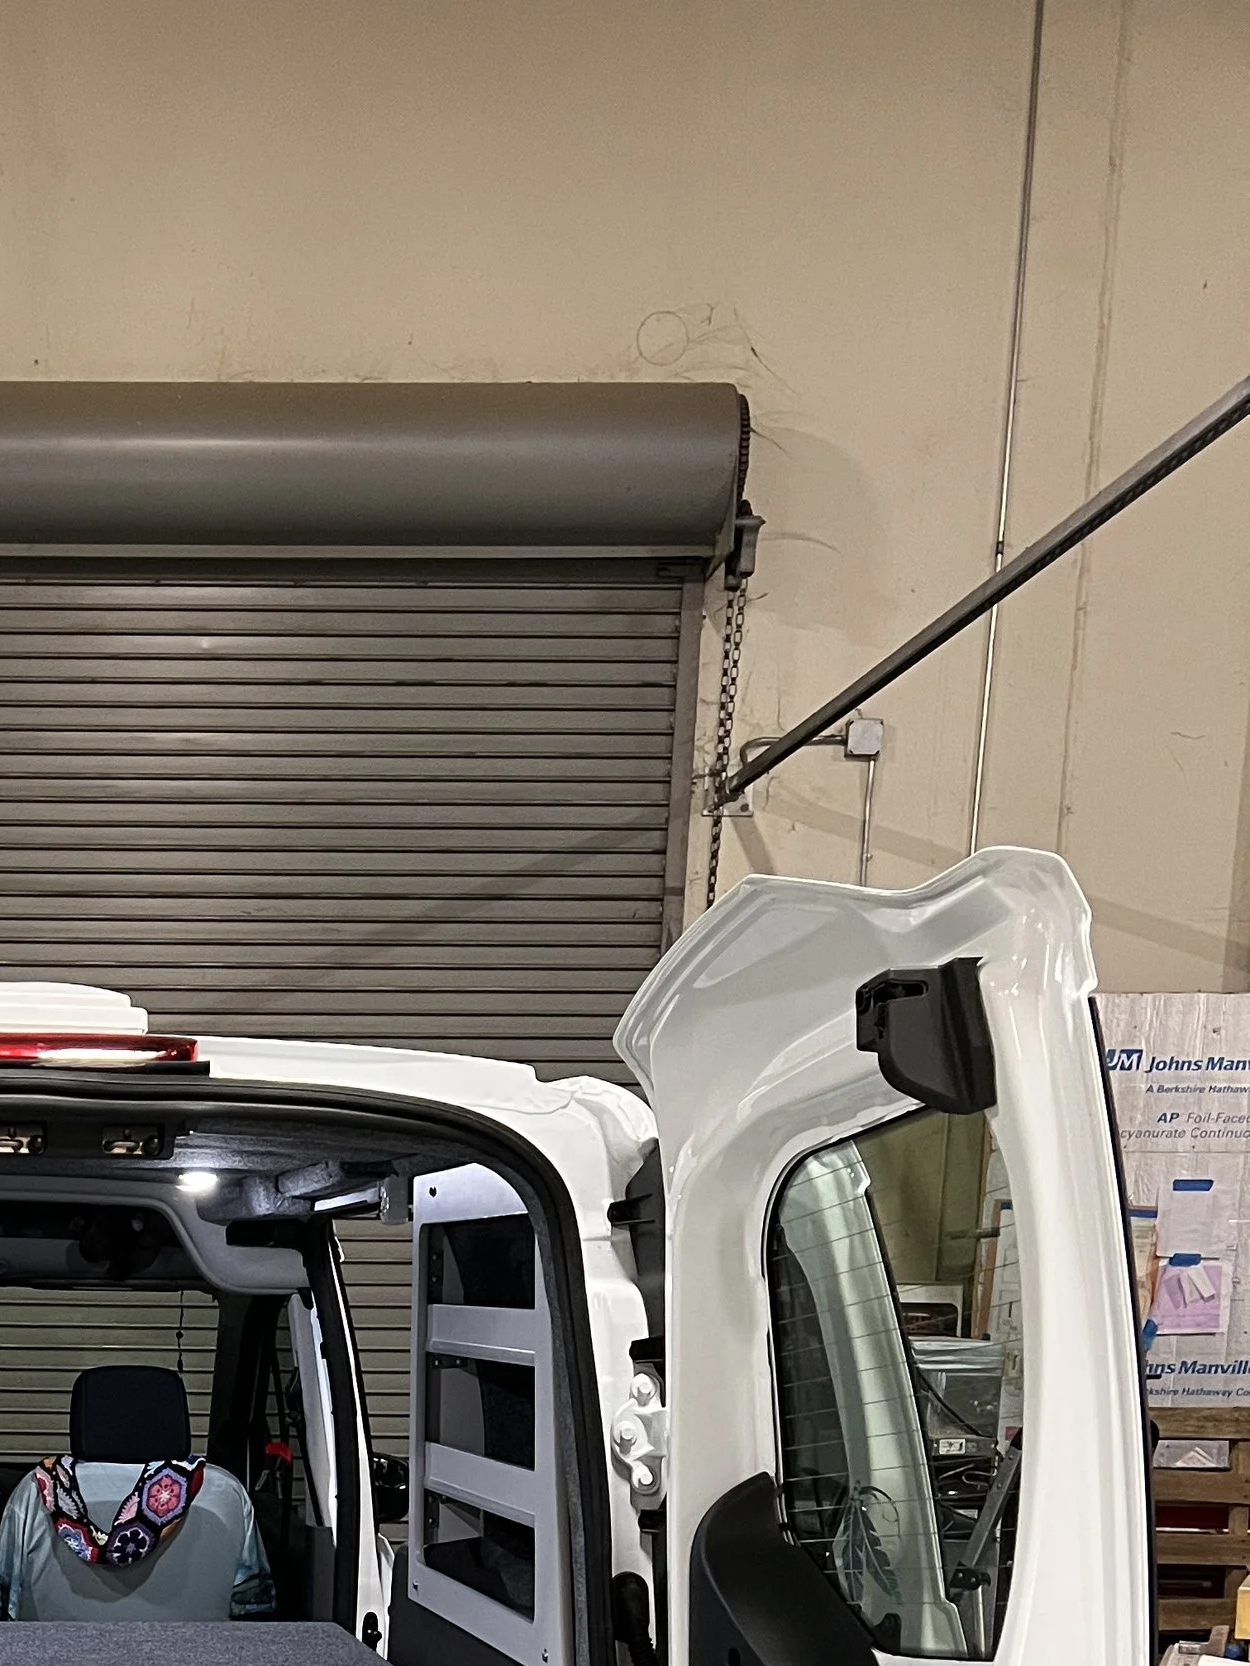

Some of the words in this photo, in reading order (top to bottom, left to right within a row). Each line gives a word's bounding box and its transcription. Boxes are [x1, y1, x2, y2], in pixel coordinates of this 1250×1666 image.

[1145, 1056, 1203, 1073] Johns
[1205, 1056, 1250, 1071] Man
[1146, 1084, 1154, 1093] A
[1157, 1084, 1206, 1093] Berkshire
[1157, 1112, 1180, 1124] AP
[1147, 1387, 1179, 1396] kshire
[1181, 1387, 1233, 1399] Hathaway
